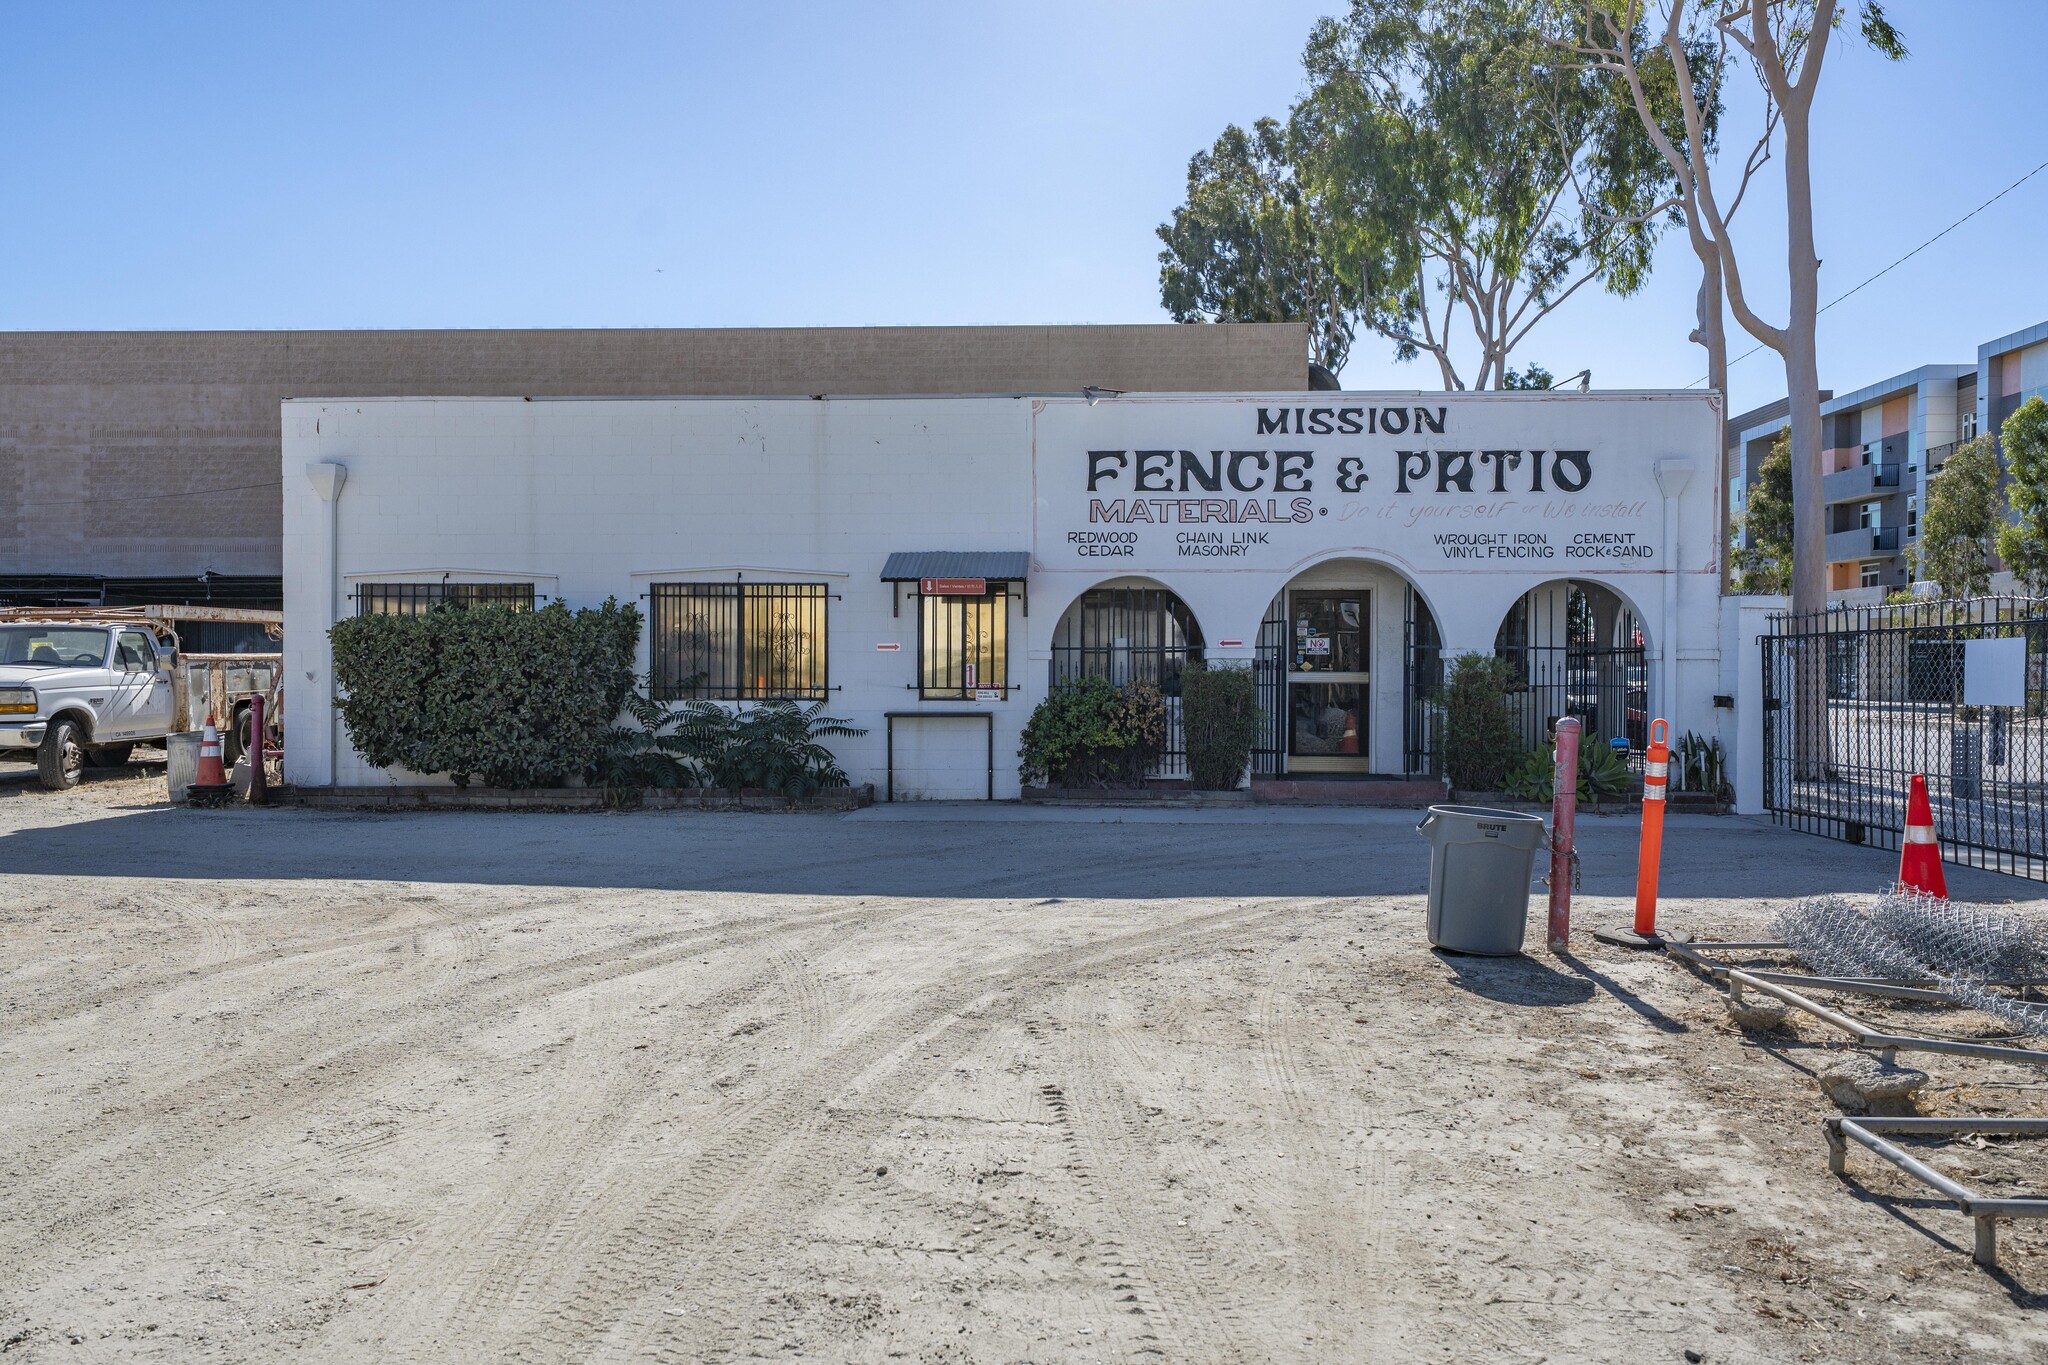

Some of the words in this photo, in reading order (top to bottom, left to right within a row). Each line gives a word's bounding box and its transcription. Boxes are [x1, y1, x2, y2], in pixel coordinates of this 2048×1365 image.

[1257, 407, 1447, 434] MISSION
[1087, 450, 1314, 492] FENCE
[1336, 457, 1369, 493] &
[1395, 450, 1592, 493] PATIO
[1090, 497, 1313, 524] MATERIALS
[1337, 501, 1369, 522] Do
[1377, 502, 1397, 519] it
[1543, 500, 1577, 518] We
[1581, 500, 1647, 518] install
[1068, 532, 1138, 544] REDWOOD
[1176, 532, 1223, 544] CHAIN
[1232, 532, 1270, 544] LINK
[1434, 534, 1508, 545] WROUGHT
[1513, 534, 1547, 544] IRON
[1573, 534, 1636, 544] CEMENT
[1078, 545, 1134, 556] CEDAR
[1178, 545, 1250, 557] MASONRY
[1442, 547, 1484, 558] VINYL
[1489, 546, 1555, 558] FENCING
[1477, 822, 1507, 832] BRUTE
